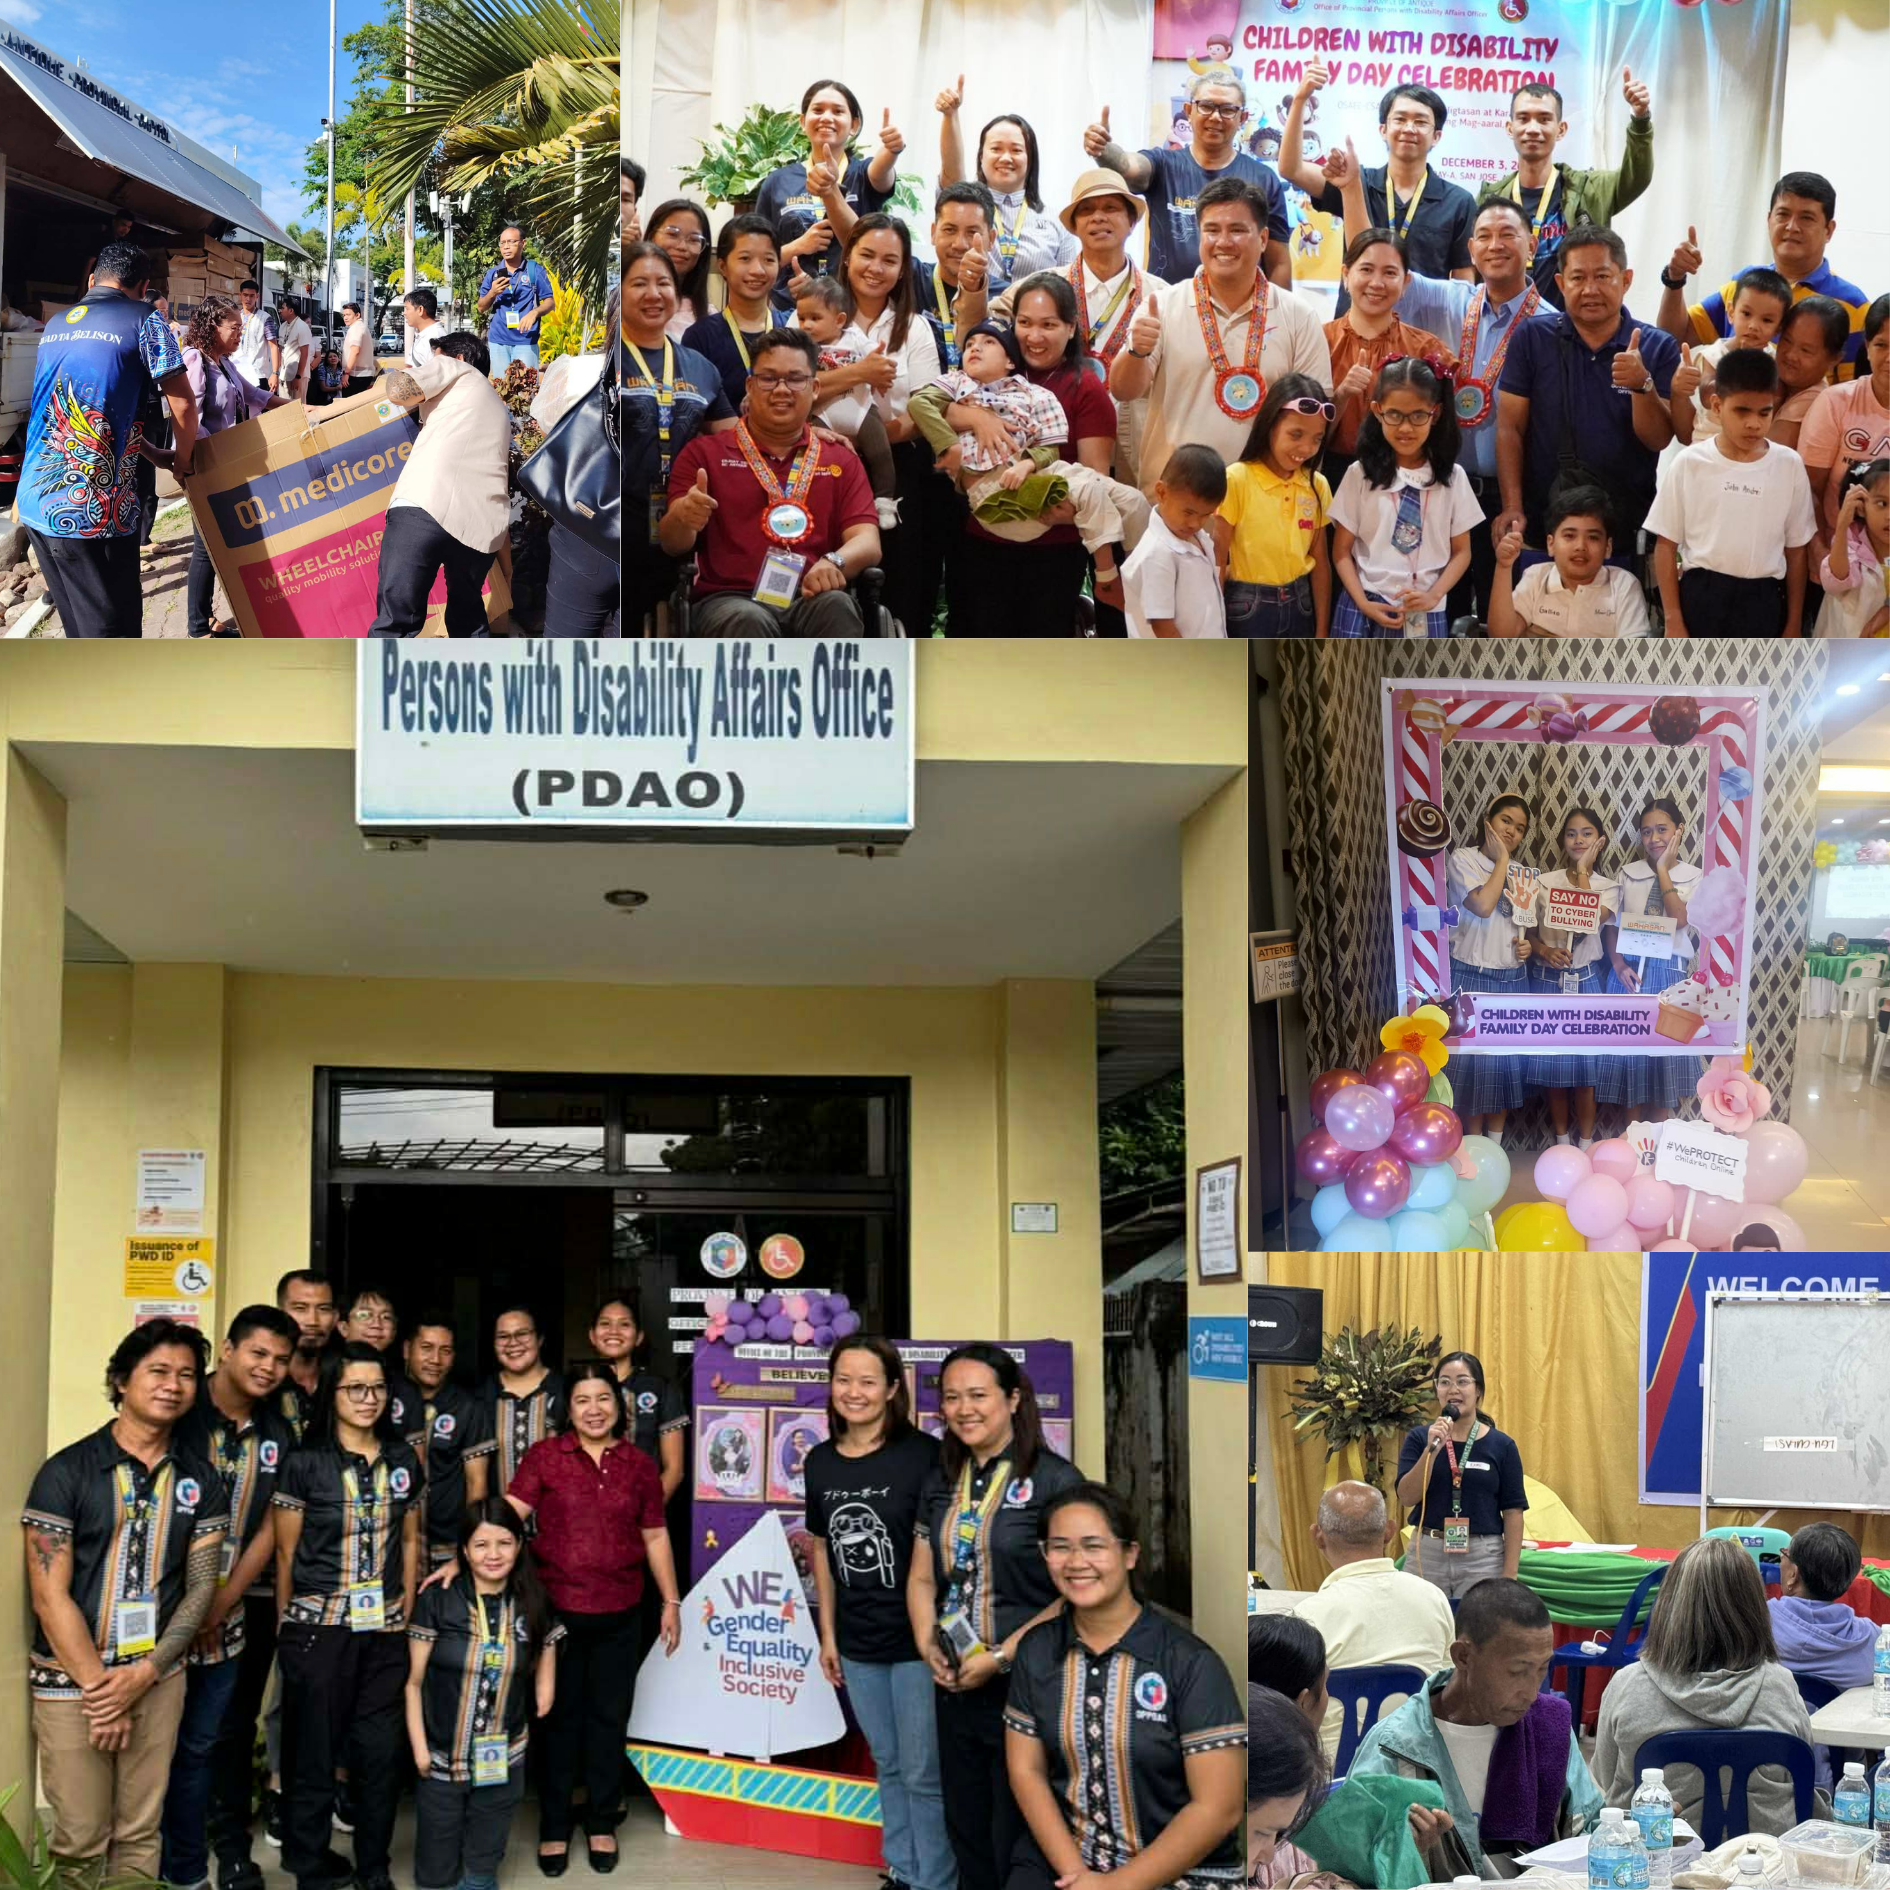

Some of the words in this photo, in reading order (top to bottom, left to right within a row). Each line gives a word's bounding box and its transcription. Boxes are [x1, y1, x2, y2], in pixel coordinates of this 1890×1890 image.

[1414, 8, 1443, 16] Disability
[1444, 9, 1466, 17] Affairs
[1243, 25, 1360, 51] CHILDREN
[1368, 30, 1423, 55] WITH
[1430, 32, 1559, 62] DISABILITY
[1, 31, 65, 81] ANTIQUE
[1254, 58, 1342, 86] FAMY
[1347, 62, 1393, 88] DAY
[1397, 65, 1556, 94] CELEBRATION
[1446, 106, 1481, 118] ligtasan
[1483, 107, 1492, 116] at
[1441, 157, 1494, 169] DECEMBER
[1460, 171, 1476, 180] SAN
[70, 329, 123, 345] BELISON
[278, 441, 413, 513] medicore
[258, 530, 384, 591] WHEELCHAIR
[265, 582, 302, 604] quality
[303, 565, 347, 588] mobility
[381, 638, 493, 734] Persons
[502, 640, 562, 735] with
[573, 639, 703, 764] Disability
[710, 642, 802, 739] Affairs
[811, 642, 895, 739] Office
[511, 768, 746, 818] (PDAO)
[1508, 864, 1540, 880] STOP
[1551, 891, 1575, 903] SAY
[1579, 893, 1598, 906] NO
[1514, 915, 1534, 924] ABUSE
[1550, 906, 1563, 914] TO
[1565, 908, 1596, 919] CYBER
[1550, 915, 1593, 928] BULLYING
[1278, 959, 1297, 969] Please
[1278, 970, 1295, 980] close
[1279, 981, 1290, 990] the
[1480, 1008, 1545, 1020] CHILDREN
[1547, 1009, 1580, 1020] WITH
[1584, 1010, 1650, 1021] DISABILITY
[1479, 1022, 1527, 1034] FAMILY
[1531, 1023, 1558, 1034] DAY
[1561, 1023, 1651, 1035] CELEBRATION
[1666, 1141, 1739, 1168] #WePROTECT
[129, 1240, 184, 1251] Issuance
[188, 1241, 200, 1251] of
[129, 1251, 159, 1261] PWD
[162, 1251, 174, 1261] ID
[1707, 1276, 1880, 1301] WELCOME
[1774, 1438, 1835, 1450] LGU-CULASI
[722, 1570, 783, 1609] WE
[706, 1610, 790, 1637] Gender
[726, 1633, 813, 1676] Equality
[719, 1654, 805, 1683] Inclusive
[723, 1674, 798, 1705] Society
